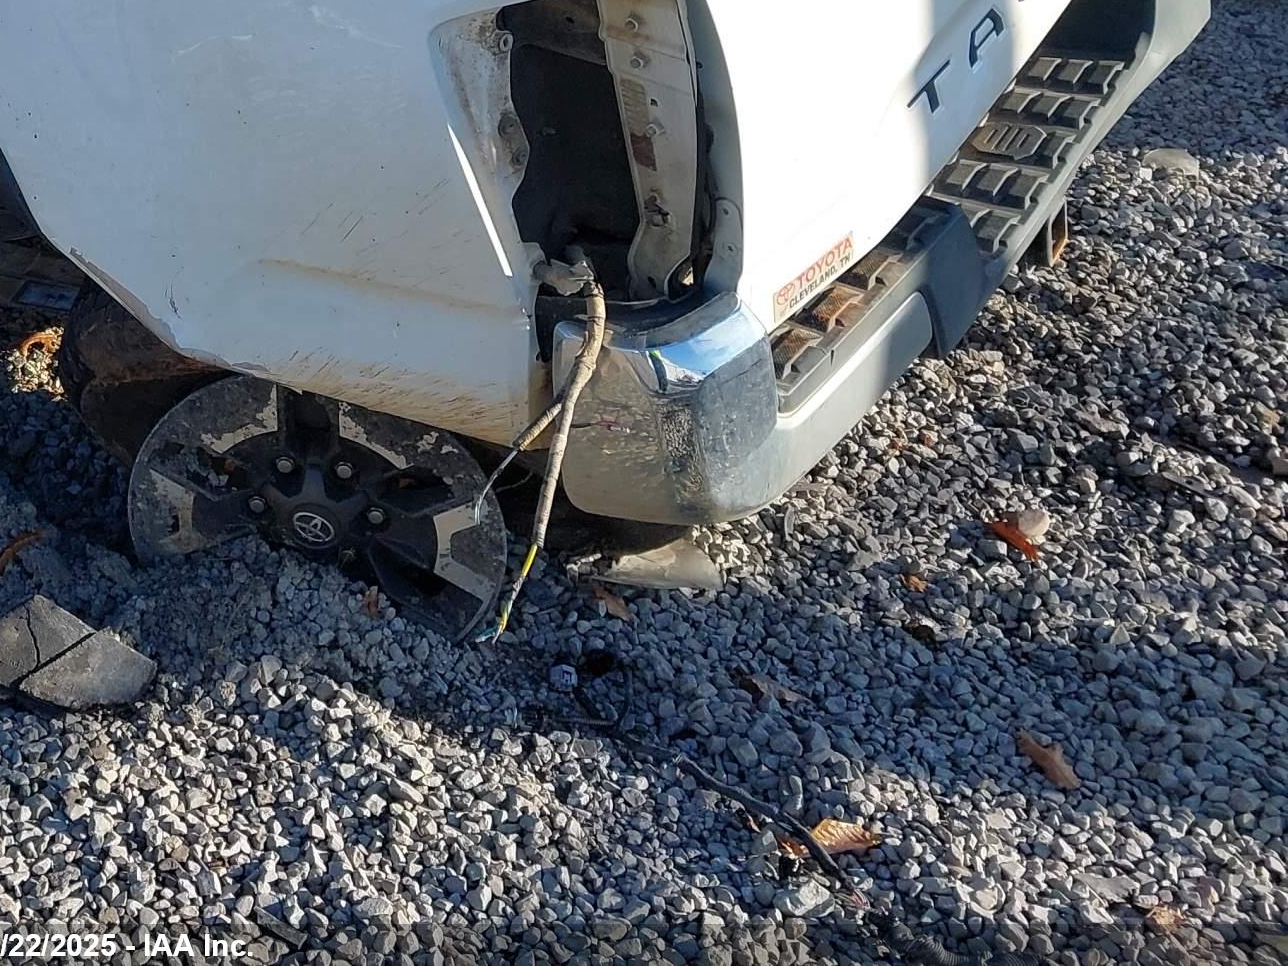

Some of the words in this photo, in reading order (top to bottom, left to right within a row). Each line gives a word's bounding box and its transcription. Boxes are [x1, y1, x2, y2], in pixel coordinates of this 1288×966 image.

[789, 265, 838, 308] CLEVELAND,
[840, 252, 851, 268] TN
[797, 237, 852, 288] TOYOTA
